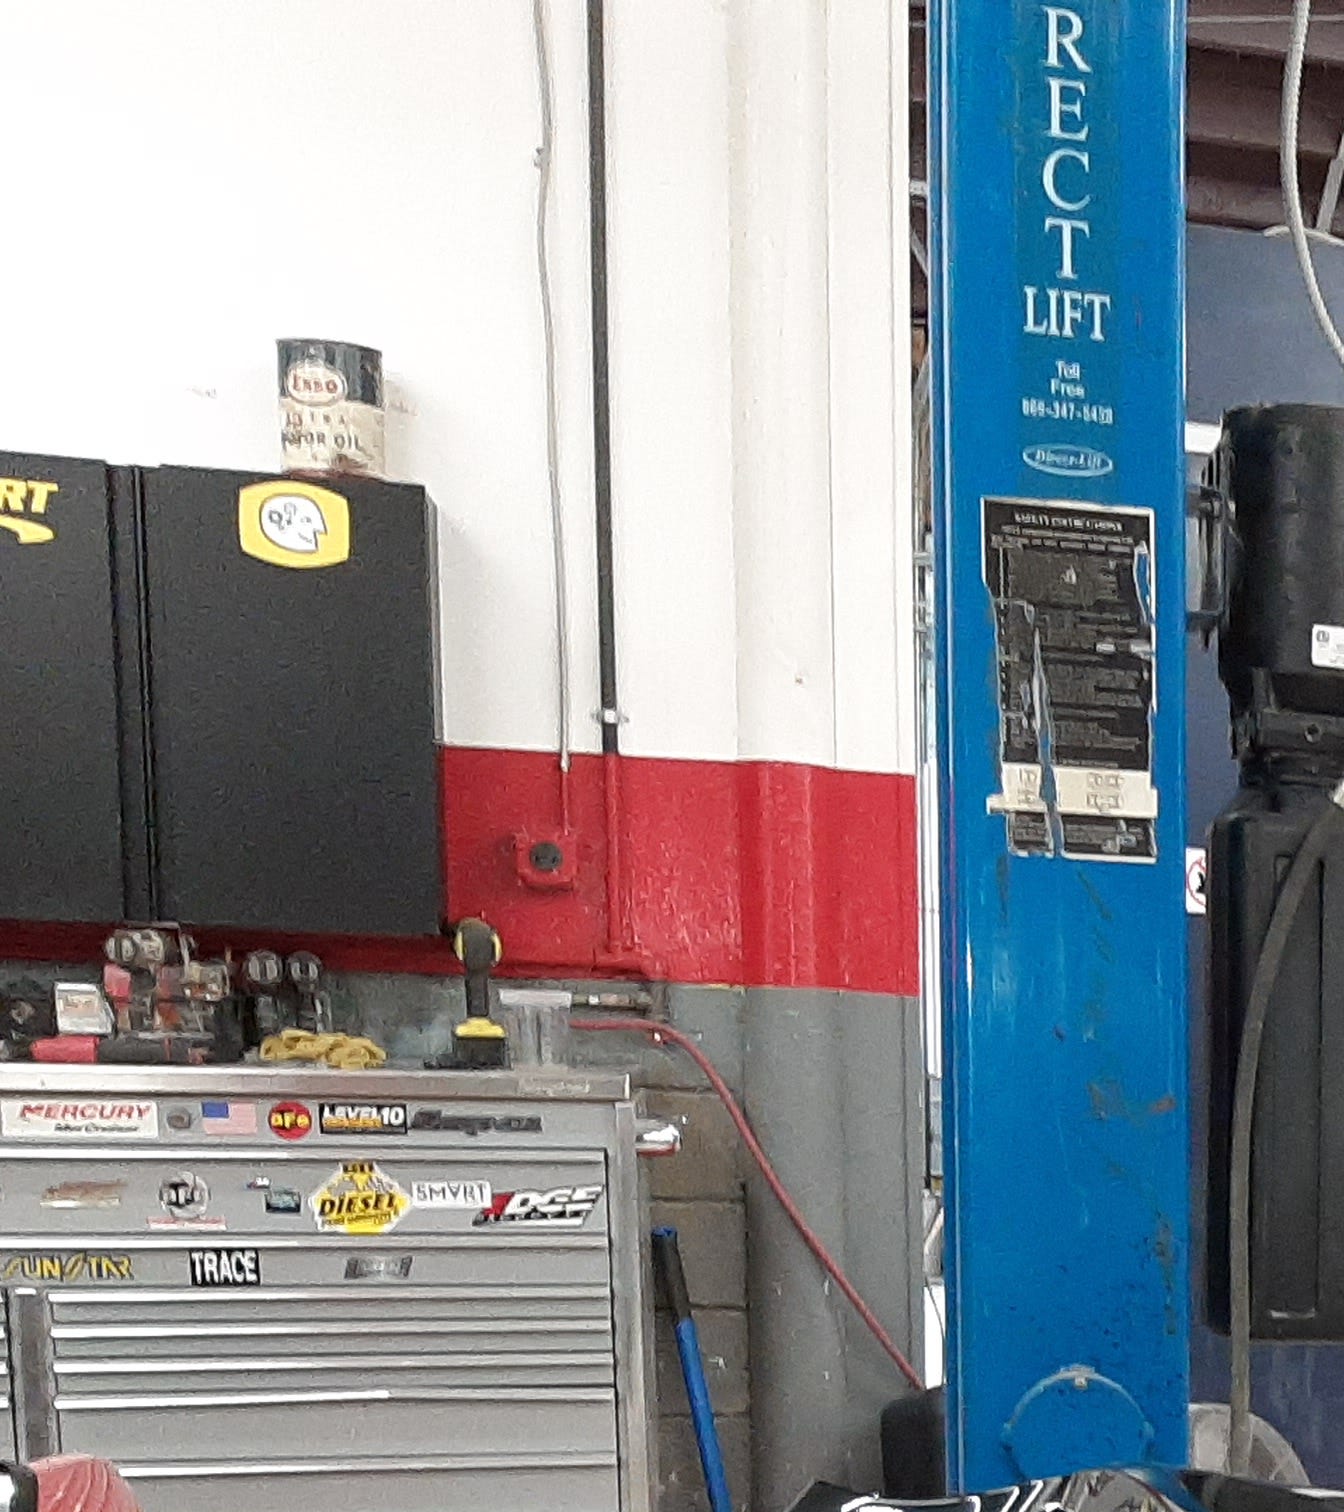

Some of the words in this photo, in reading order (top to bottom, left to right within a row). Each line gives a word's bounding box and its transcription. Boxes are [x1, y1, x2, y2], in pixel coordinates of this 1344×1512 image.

[1023, 285, 1112, 342] LIFT
[0, 477, 59, 514] RT
[191, 1251, 258, 1284] TRACE
